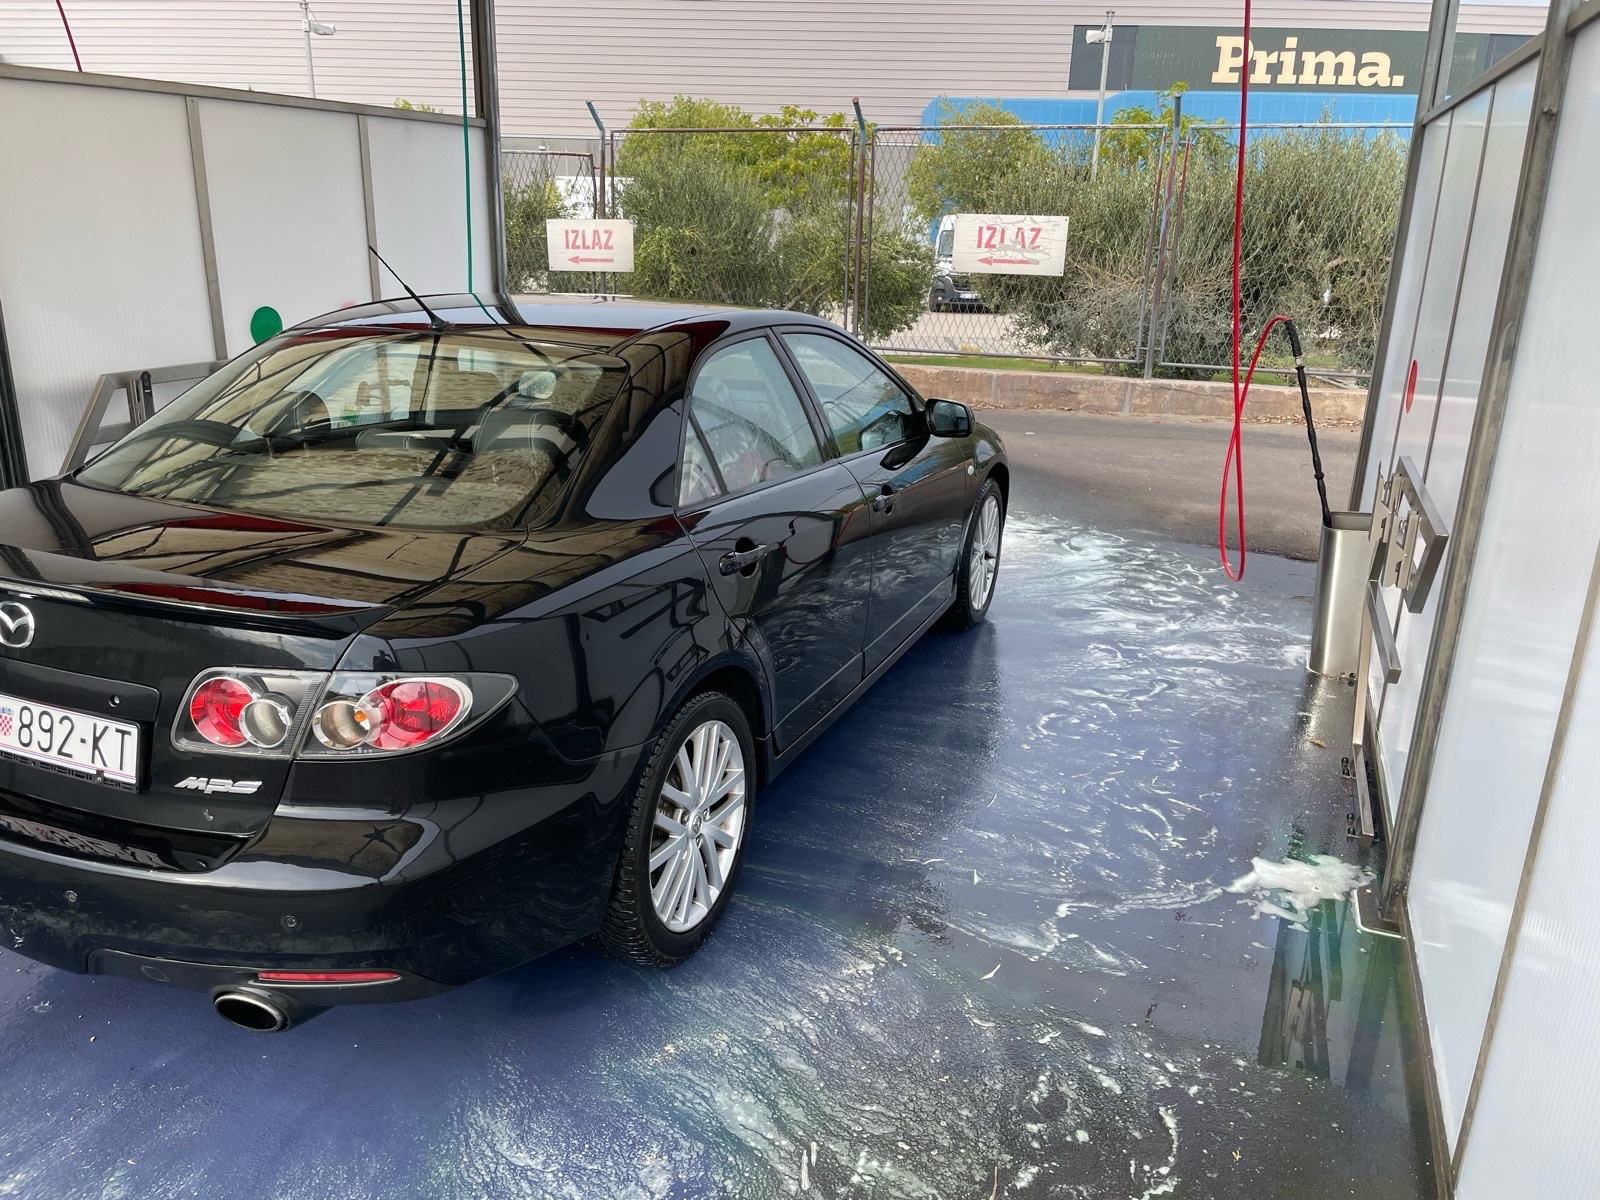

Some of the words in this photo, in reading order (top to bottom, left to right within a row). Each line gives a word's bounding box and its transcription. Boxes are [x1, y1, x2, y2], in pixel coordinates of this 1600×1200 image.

[1211, 35, 1405, 87] Prima.
[564, 229, 615, 251] IZLAZ
[17, 705, 132, 771] 892-KT
[173, 776, 263, 795] MPS
